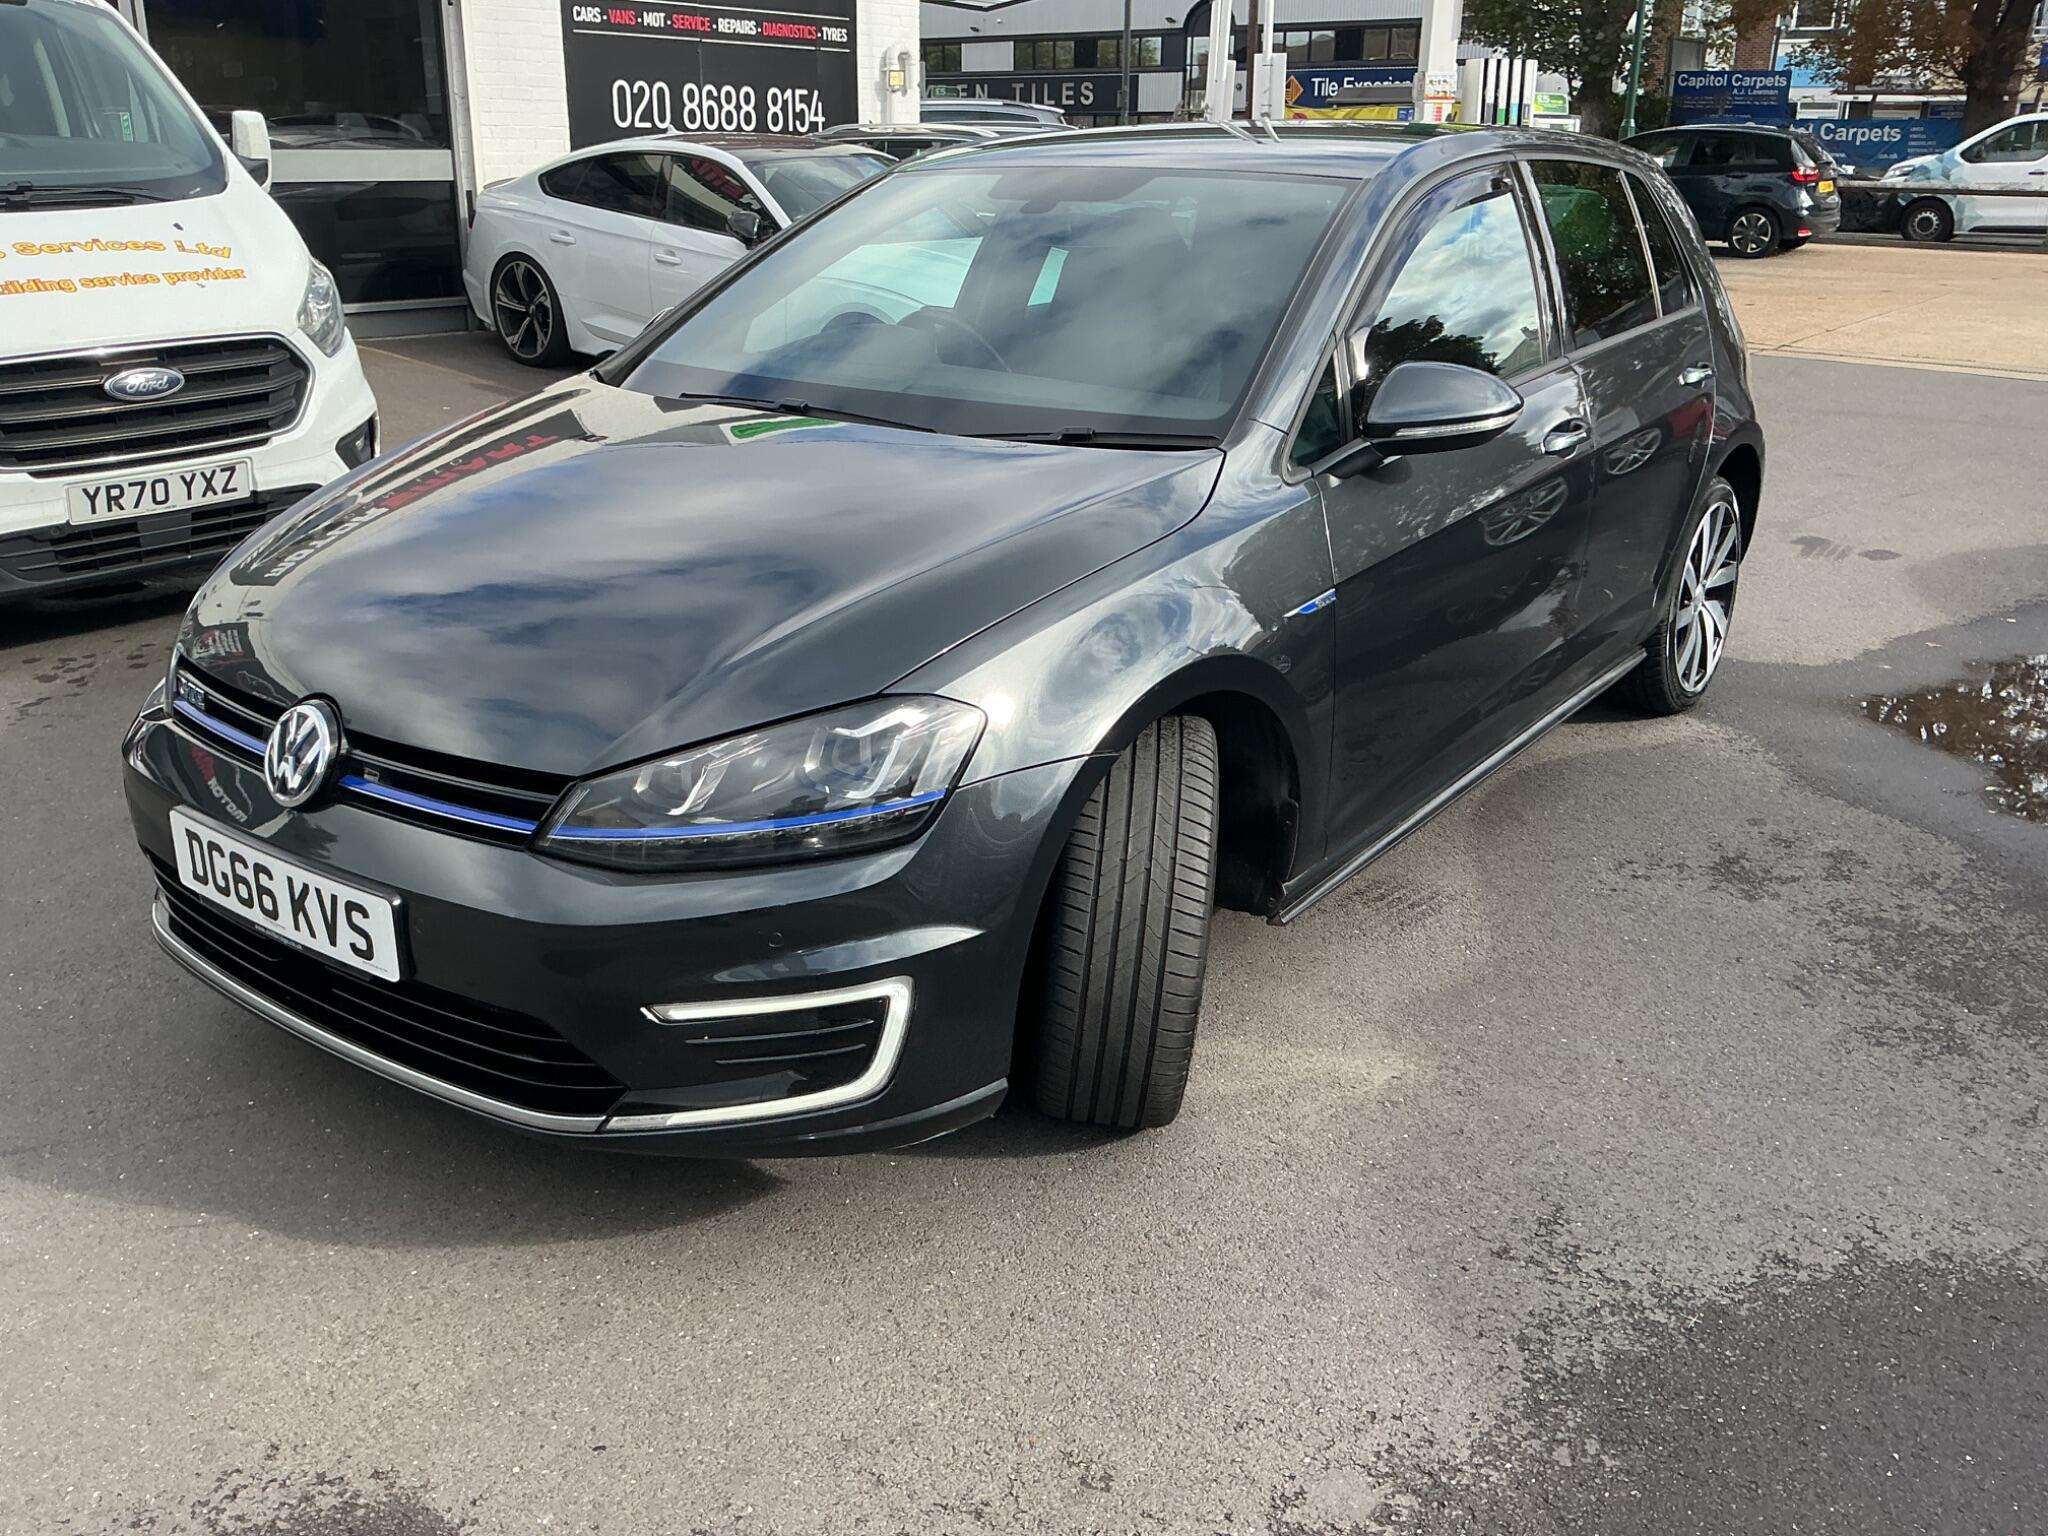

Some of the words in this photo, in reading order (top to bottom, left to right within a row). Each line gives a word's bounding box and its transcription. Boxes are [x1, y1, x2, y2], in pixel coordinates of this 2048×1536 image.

[573, 5, 601, 23] CARS
[608, 8, 636, 26] VANS
[643, 11, 665, 27] MOT
[672, 13, 711, 32] SERVICE
[718, 18, 757, 35] REPAIRS
[762, 21, 817, 40] DIAGNOSTICS
[822, 26, 848, 42] TYRES
[1012, 81, 1095, 106] TILES
[1311, 77, 1339, 97] Tile
[1678, 73, 1728, 89] Capitol
[1731, 73, 1787, 90] Carpets
[611, 79, 671, 129] 020
[682, 82, 757, 132] 8688
[766, 86, 826, 133] 8154
[1820, 122, 1902, 146] Carpets
[12, 238, 167, 256] Services
[174, 239, 232, 259] Ltd
[78, 272, 161, 289] service
[162, 267, 248, 286] provider
[82, 478, 170, 515] YR70
[179, 465, 238, 501] YXZ
[184, 827, 280, 922] DG66
[287, 874, 375, 962] KVS
